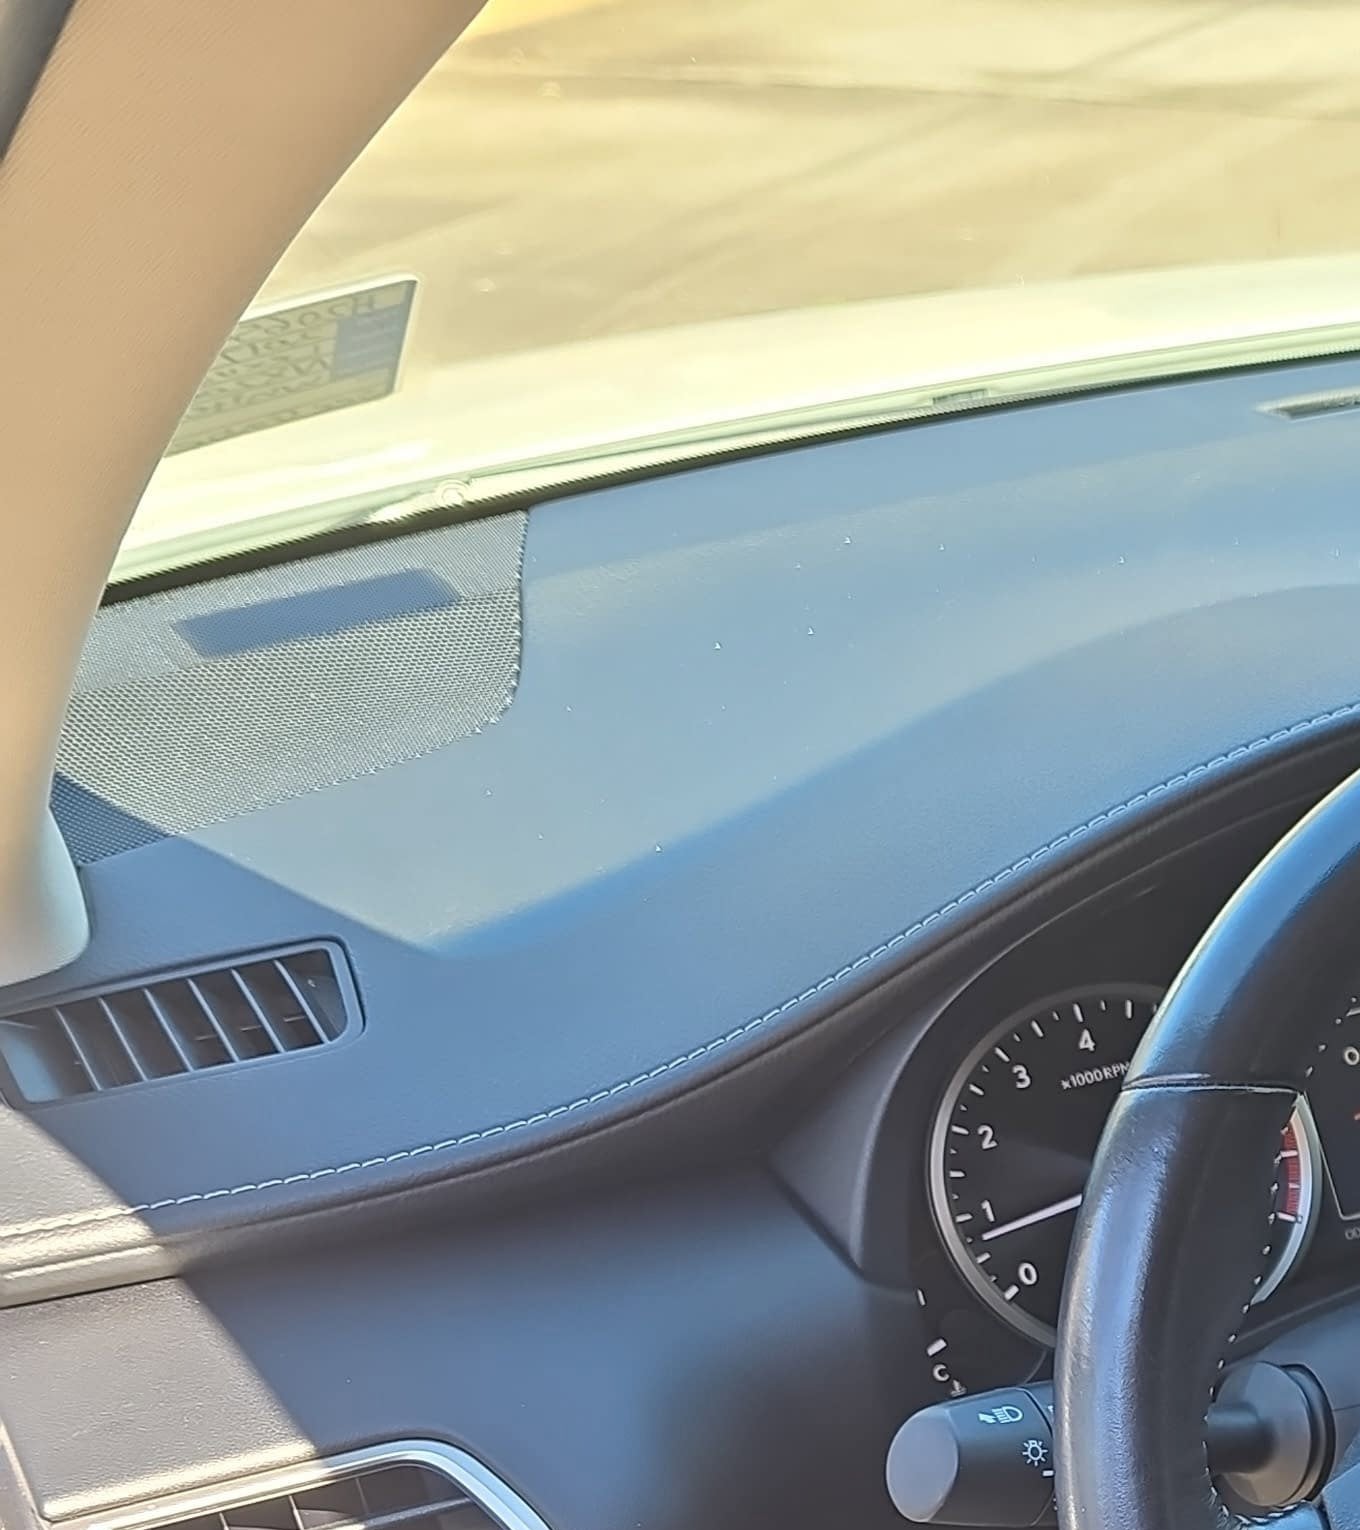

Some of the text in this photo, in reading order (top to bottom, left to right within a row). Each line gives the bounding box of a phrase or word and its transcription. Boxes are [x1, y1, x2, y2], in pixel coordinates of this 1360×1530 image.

[1078, 1028, 1096, 1052] 4
[1012, 1064, 1031, 1089] 3
[977, 1125, 998, 1150] 2
[981, 1199, 995, 1223] 1
[1018, 1262, 1038, 1286] 0
[932, 1363, 950, 1382] C
